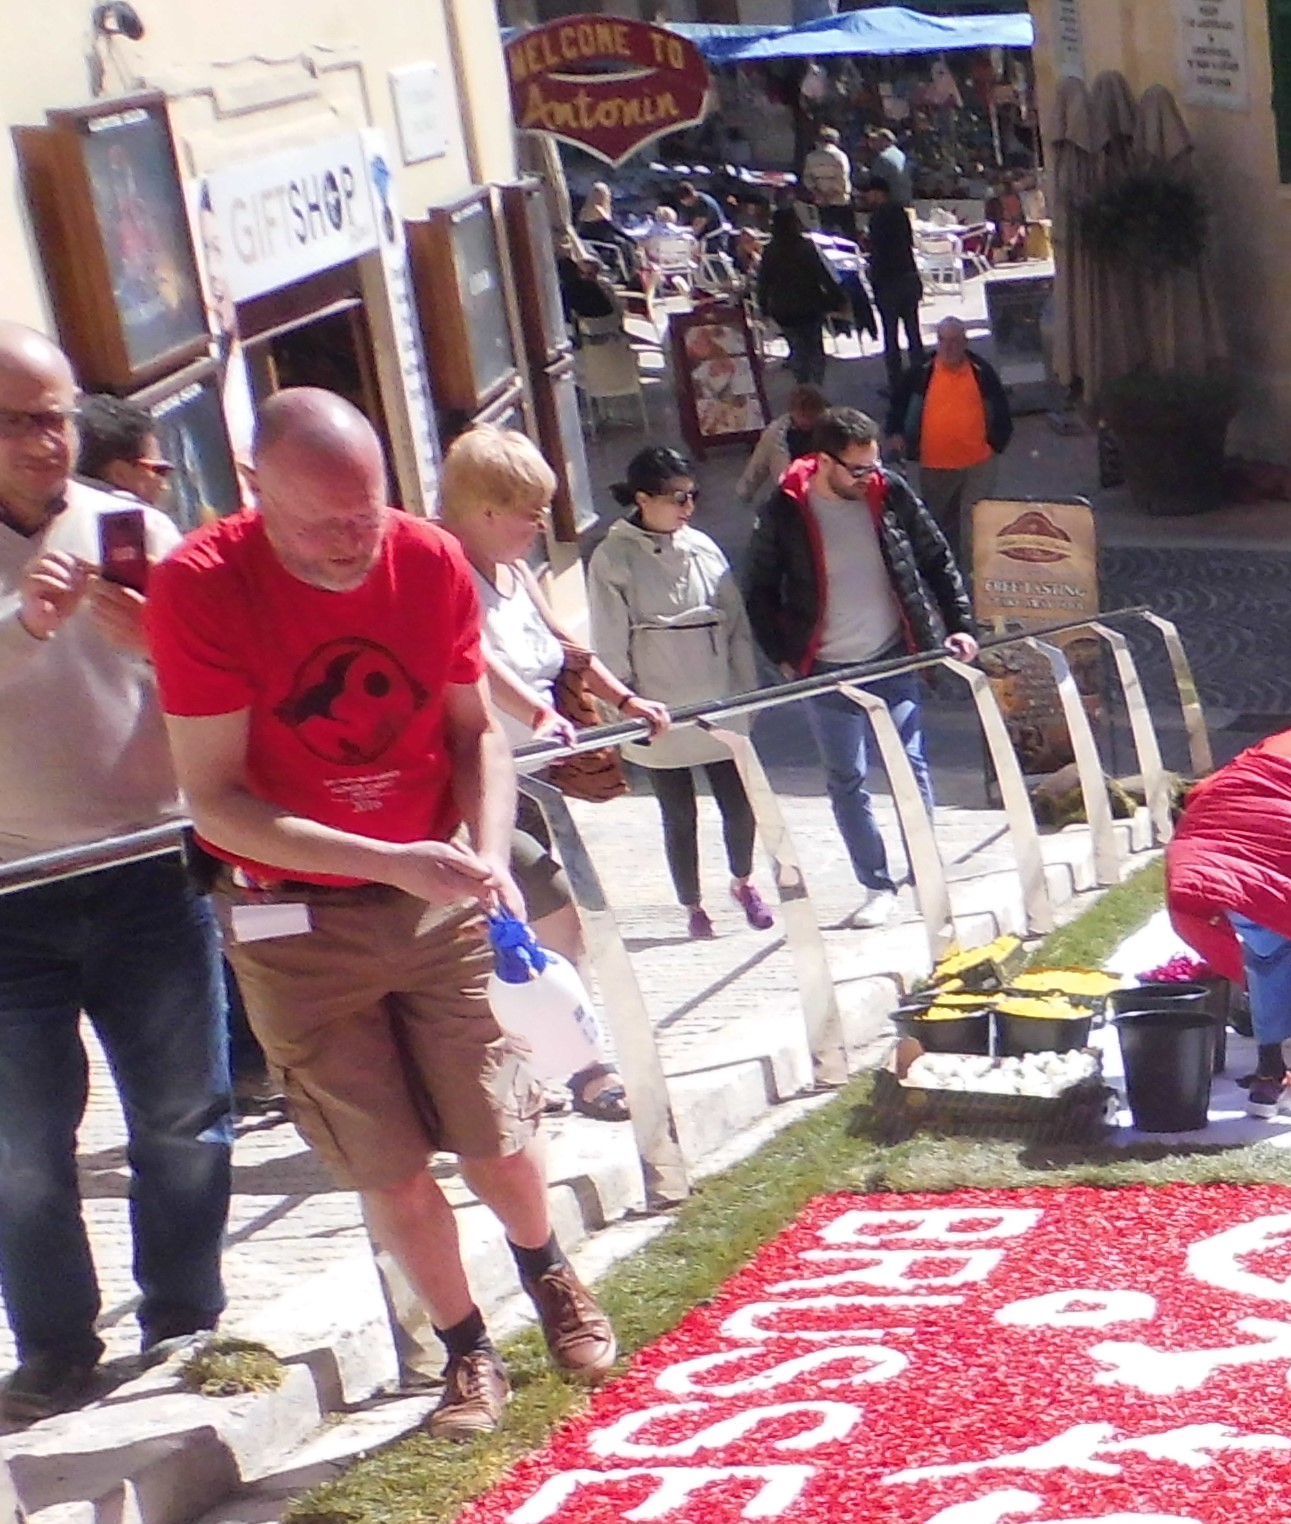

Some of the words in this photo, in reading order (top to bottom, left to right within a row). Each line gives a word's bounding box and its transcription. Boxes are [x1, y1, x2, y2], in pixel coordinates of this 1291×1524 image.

[508, 22, 631, 81] WELCOME
[649, 31, 685, 70] TO
[1024, 581, 1086, 596] TASTING
